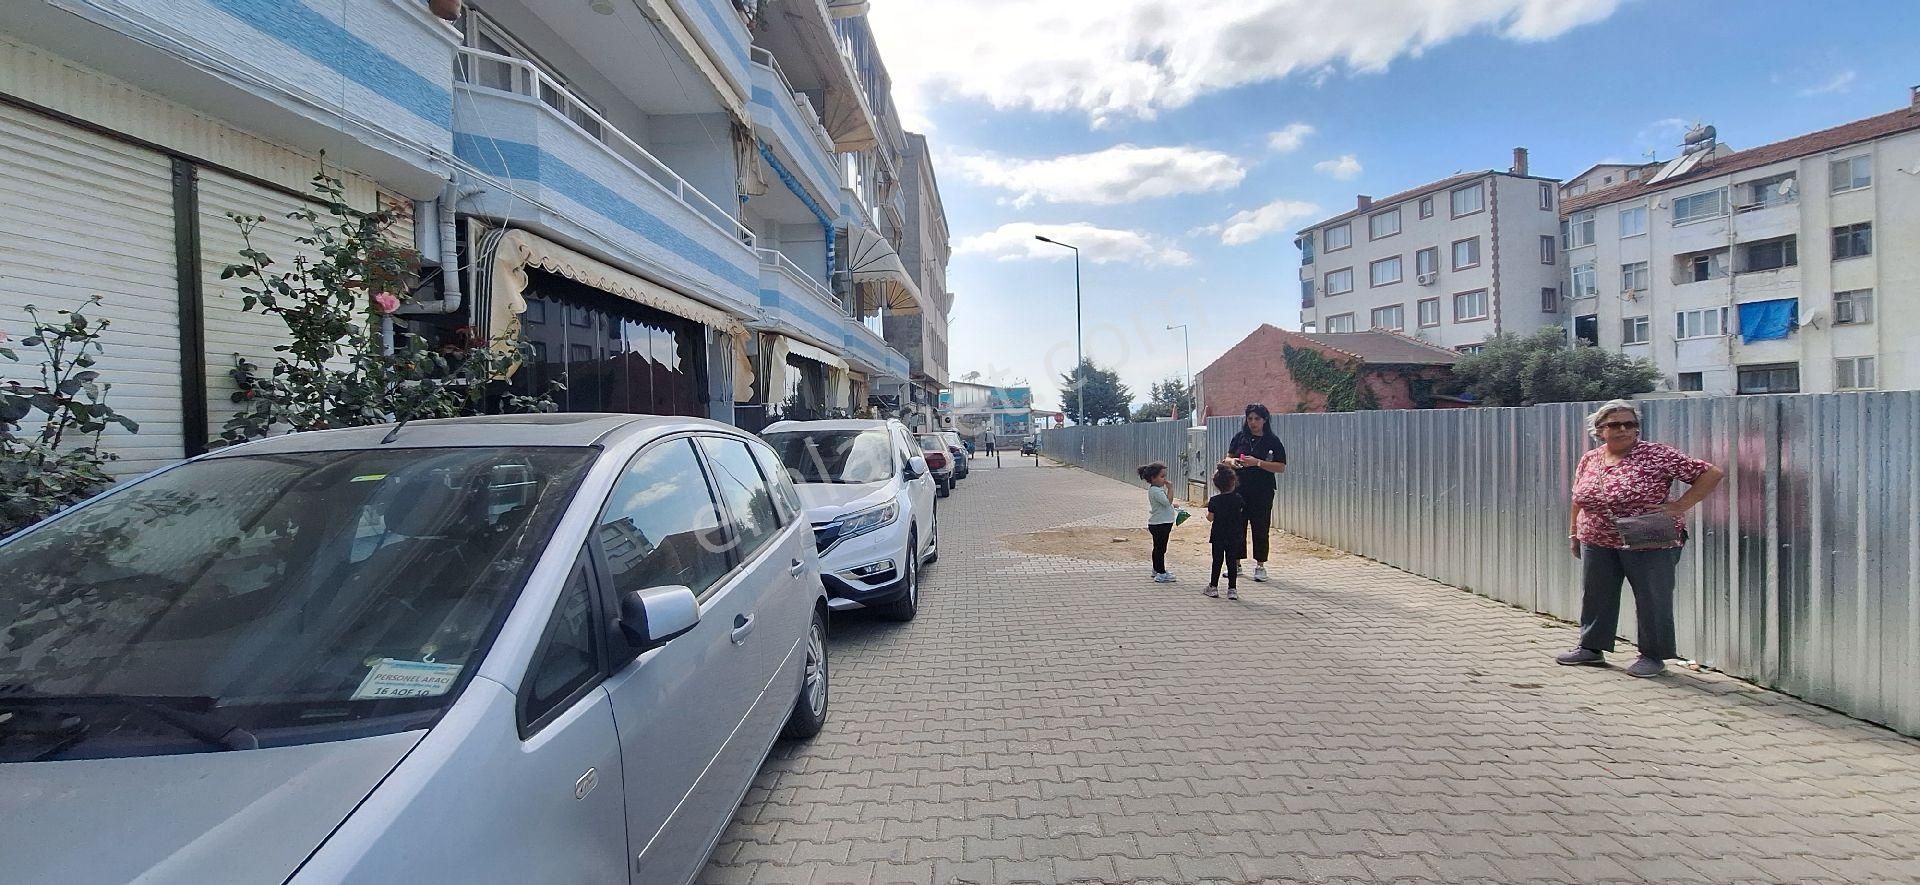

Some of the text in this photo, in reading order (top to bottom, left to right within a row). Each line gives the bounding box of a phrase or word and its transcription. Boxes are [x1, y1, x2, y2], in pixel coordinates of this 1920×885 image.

[374, 673, 450, 684] PERSONEL ARACI
[374, 687, 389, 695] 16
